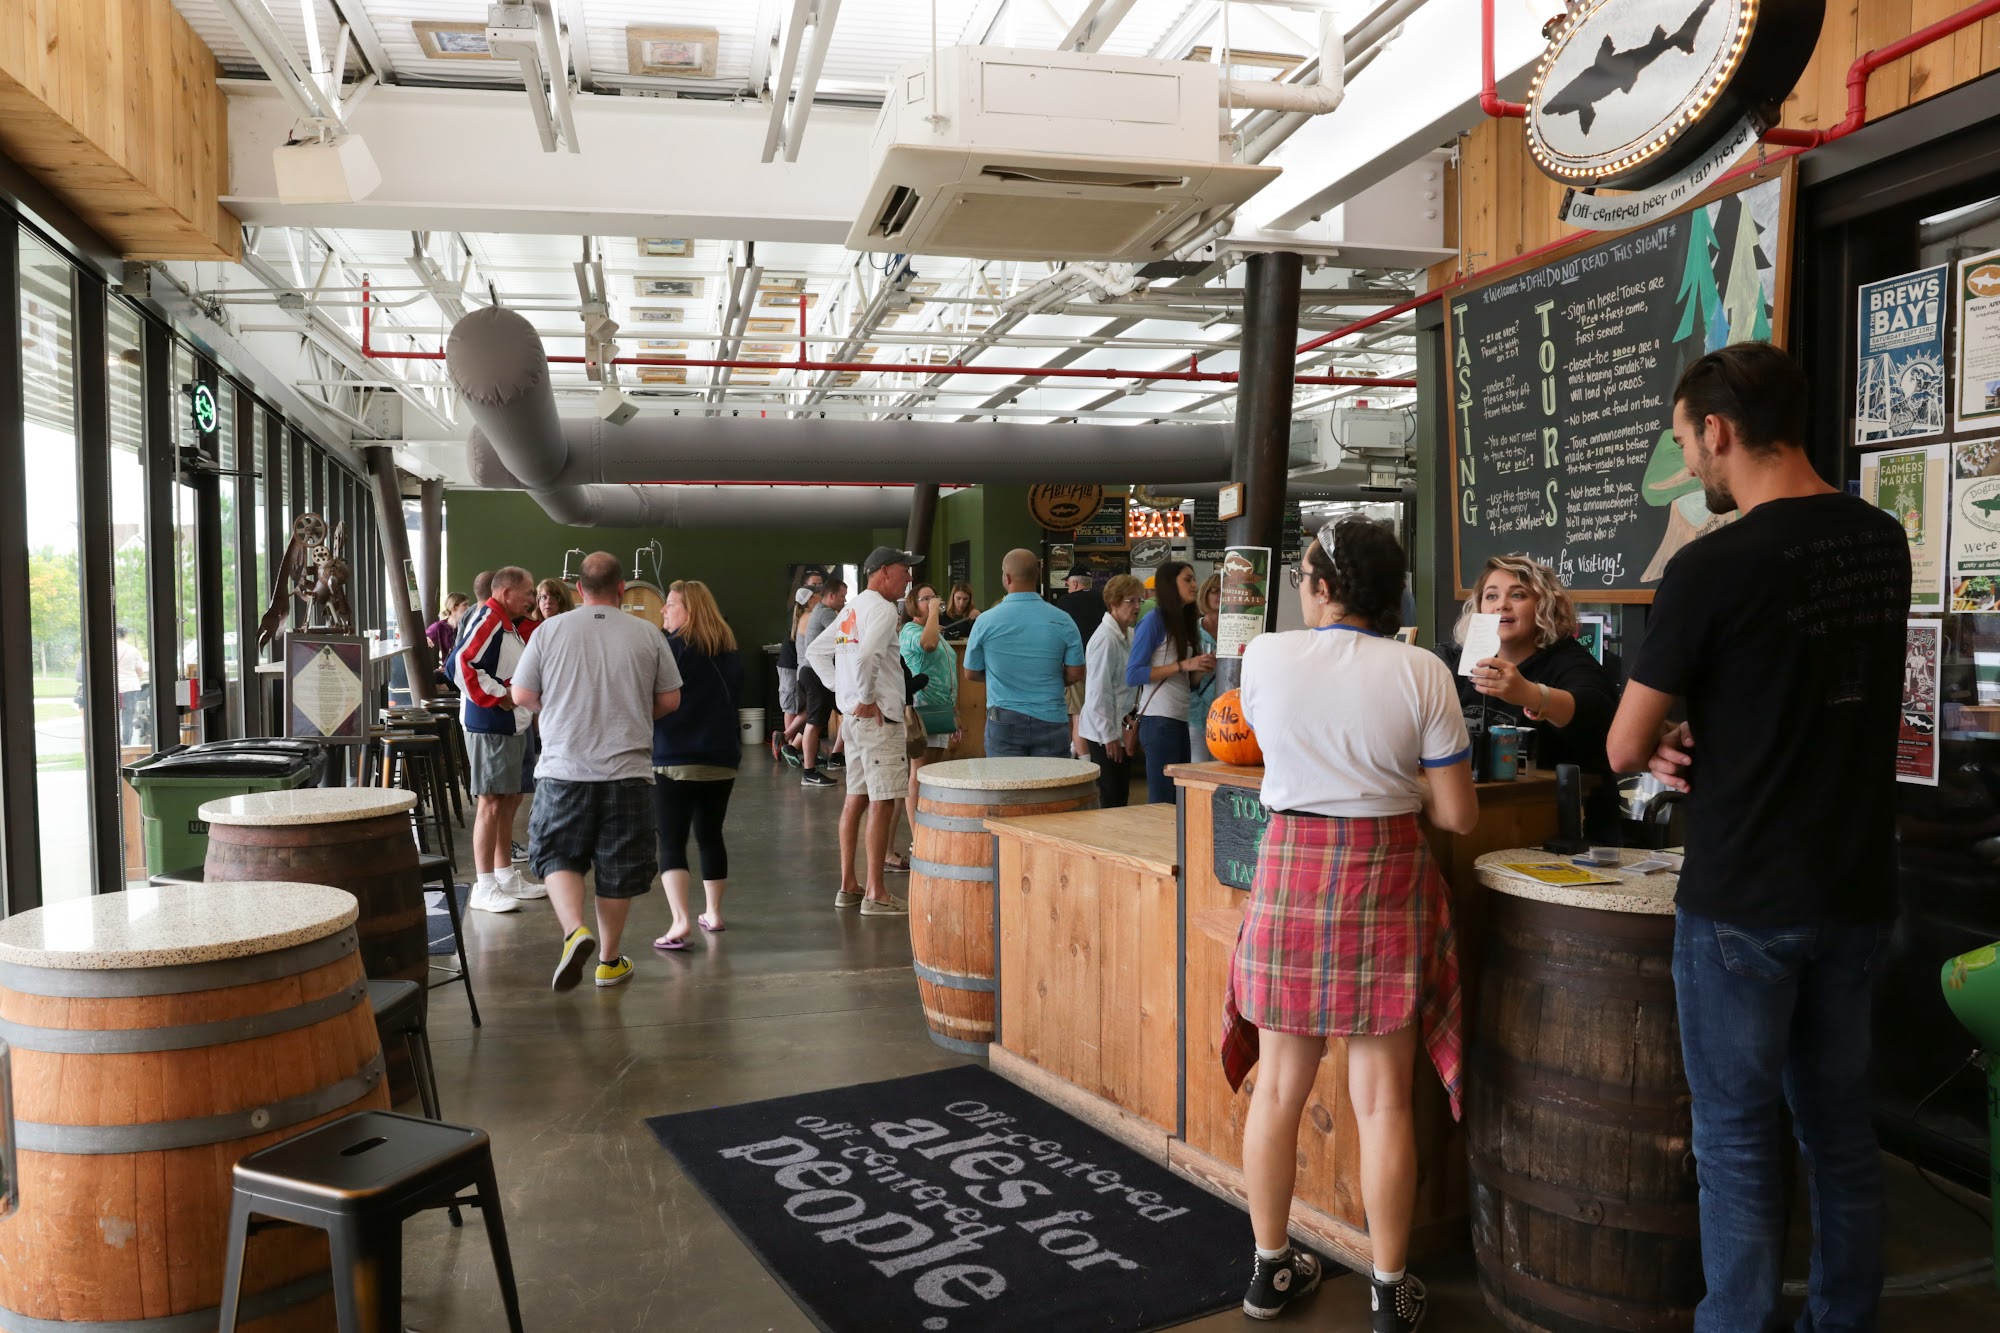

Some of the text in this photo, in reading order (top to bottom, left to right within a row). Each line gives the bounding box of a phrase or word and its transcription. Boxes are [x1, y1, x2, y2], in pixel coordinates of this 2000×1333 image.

[1572, 127, 1749, 223] Off-centered beer on tap here!
[1526, 268, 1547, 292] DFH!
[1560, 257, 1581, 280] NOT
[1581, 252, 1609, 273] READ
[1609, 243, 1634, 263] THIS
[1587, 297, 1596, 310] in
[1597, 286, 1620, 309] here!
[1871, 278, 1940, 312] BREWS
[1625, 300, 1649, 316] come,
[1874, 300, 1926, 336] BAY
[1498, 342, 1505, 353] it
[1505, 336, 1520, 350] with
[1871, 332, 1904, 344] SATURDAY
[1903, 328, 1918, 337] SEPT
[1918, 325, 1935, 334] 23RD
[1612, 344, 1637, 358] shoes
[1654, 338, 1660, 349] a
[1496, 354, 1505, 363] an
[1645, 355, 1658, 369] We
[1505, 388, 1520, 403] stay
[1585, 384, 1600, 401] lend
[1603, 384, 1617, 401] you
[1453, 303, 1478, 527] TASTING
[1501, 403, 1512, 414] the
[1535, 299, 1560, 528] TOURS
[1612, 400, 1629, 416] food
[1630, 400, 1641, 411] on
[1500, 434, 1508, 446] do
[1521, 429, 1537, 442] need
[1589, 421, 1644, 443] announcements
[1482, 453, 1490, 463] to
[1505, 448, 1513, 458] to
[1565, 451, 1585, 464] made
[1604, 444, 1624, 454] mins
[1566, 451, 1647, 475] the Be here!
[1889, 455, 1916, 464] MILTON
[1880, 461, 1925, 476] FARMERS'
[1880, 472, 1924, 487] MARKET
[1502, 486, 1540, 506] the tasting
[1584, 486, 1602, 497] here
[1501, 505, 1509, 515] to
[1509, 502, 1528, 518] enjoy
[1583, 493, 1639, 512] announcement?
[1129, 509, 1187, 538] BAR
[1489, 520, 1497, 537] 4
[1566, 515, 1580, 528] We'll
[1581, 517, 1594, 532] give
[1612, 511, 1628, 526] spot
[1628, 510, 1638, 522] to
[1695, 515, 1720, 539] analog
[1566, 530, 1593, 545] Someone
[1593, 528, 1608, 542] who
[1783, 544, 1802, 561] NO
[1808, 537, 1836, 553] IDEA
[1839, 535, 1851, 548] IS
[1964, 541, 1998, 553] We're
[1557, 548, 1575, 575] for
[1826, 567, 1900, 592] CONFUSION
[1218, 705, 1239, 725] Ale
[1219, 727, 1250, 743] Now
[943, 1098, 1192, 1225] Off-centered
[794, 1113, 1007, 1243] off-centered
[869, 1116, 1140, 1273] ales for
